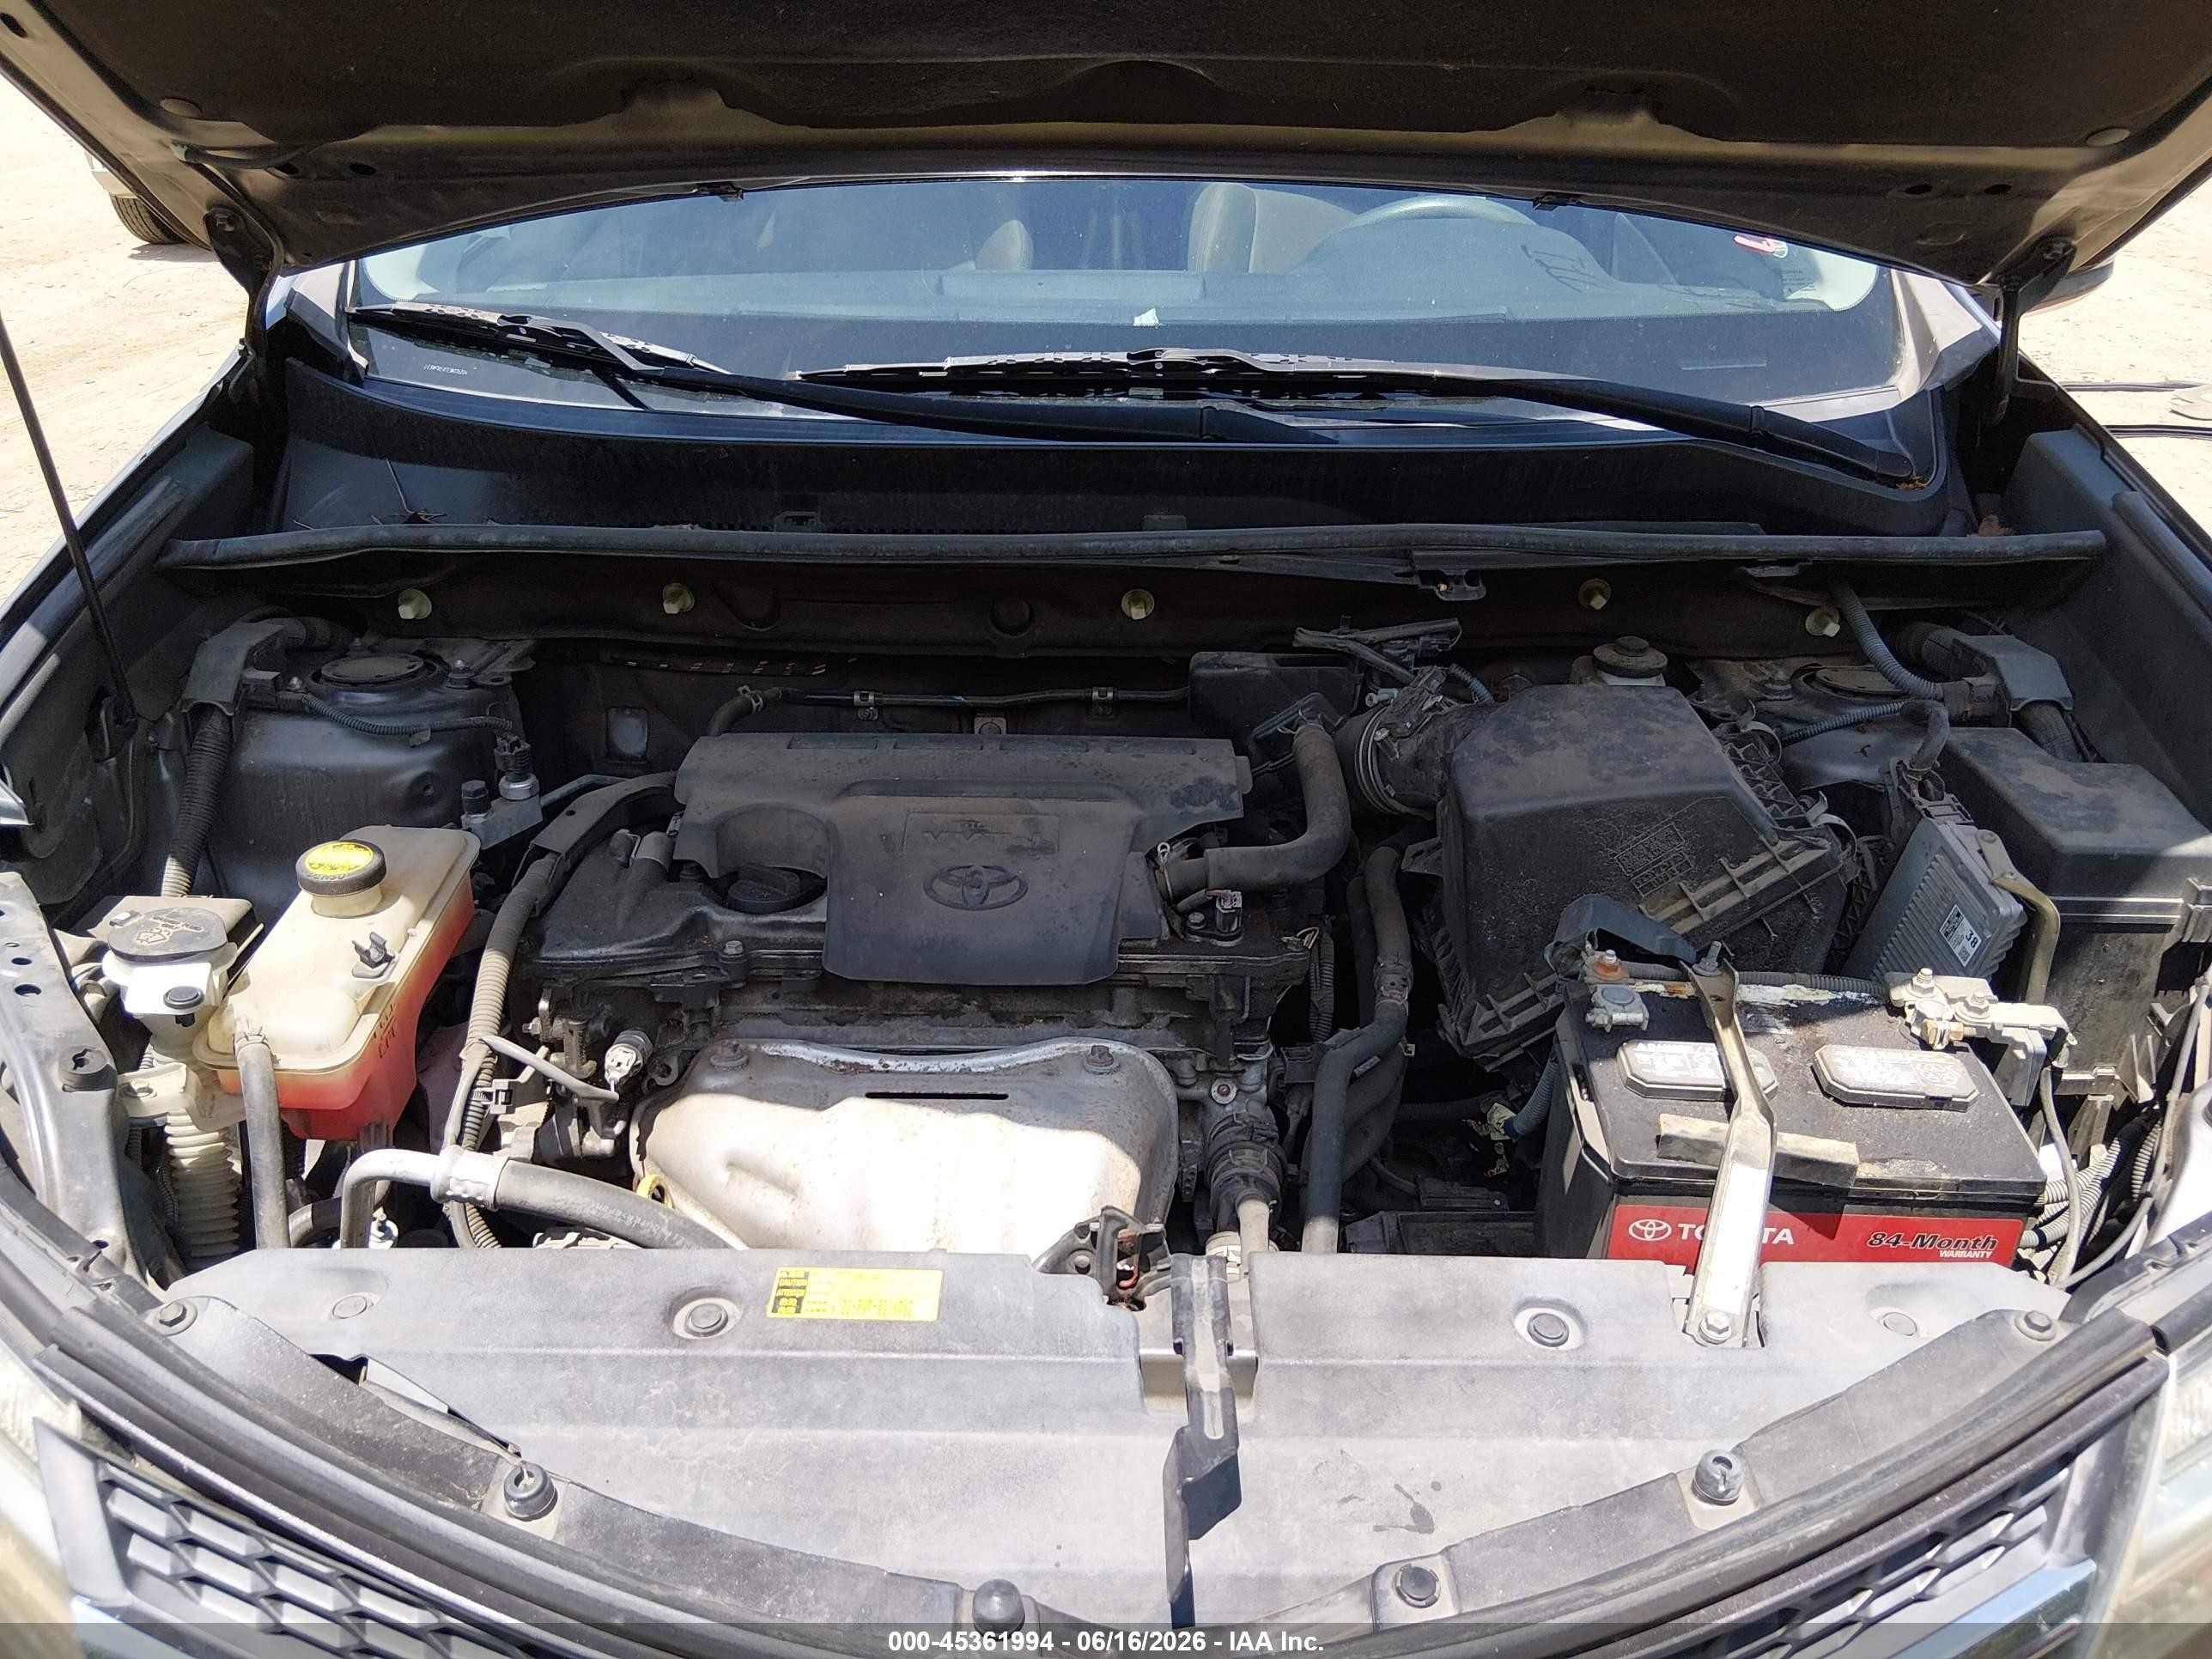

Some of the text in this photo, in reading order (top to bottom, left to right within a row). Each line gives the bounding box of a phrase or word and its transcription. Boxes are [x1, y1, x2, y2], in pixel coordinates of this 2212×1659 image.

[1677, 1223, 1795, 1245] TOTA
[1867, 1231, 1999, 1251] 84-Month
[1939, 1249, 1993, 1259] WARRANTY
